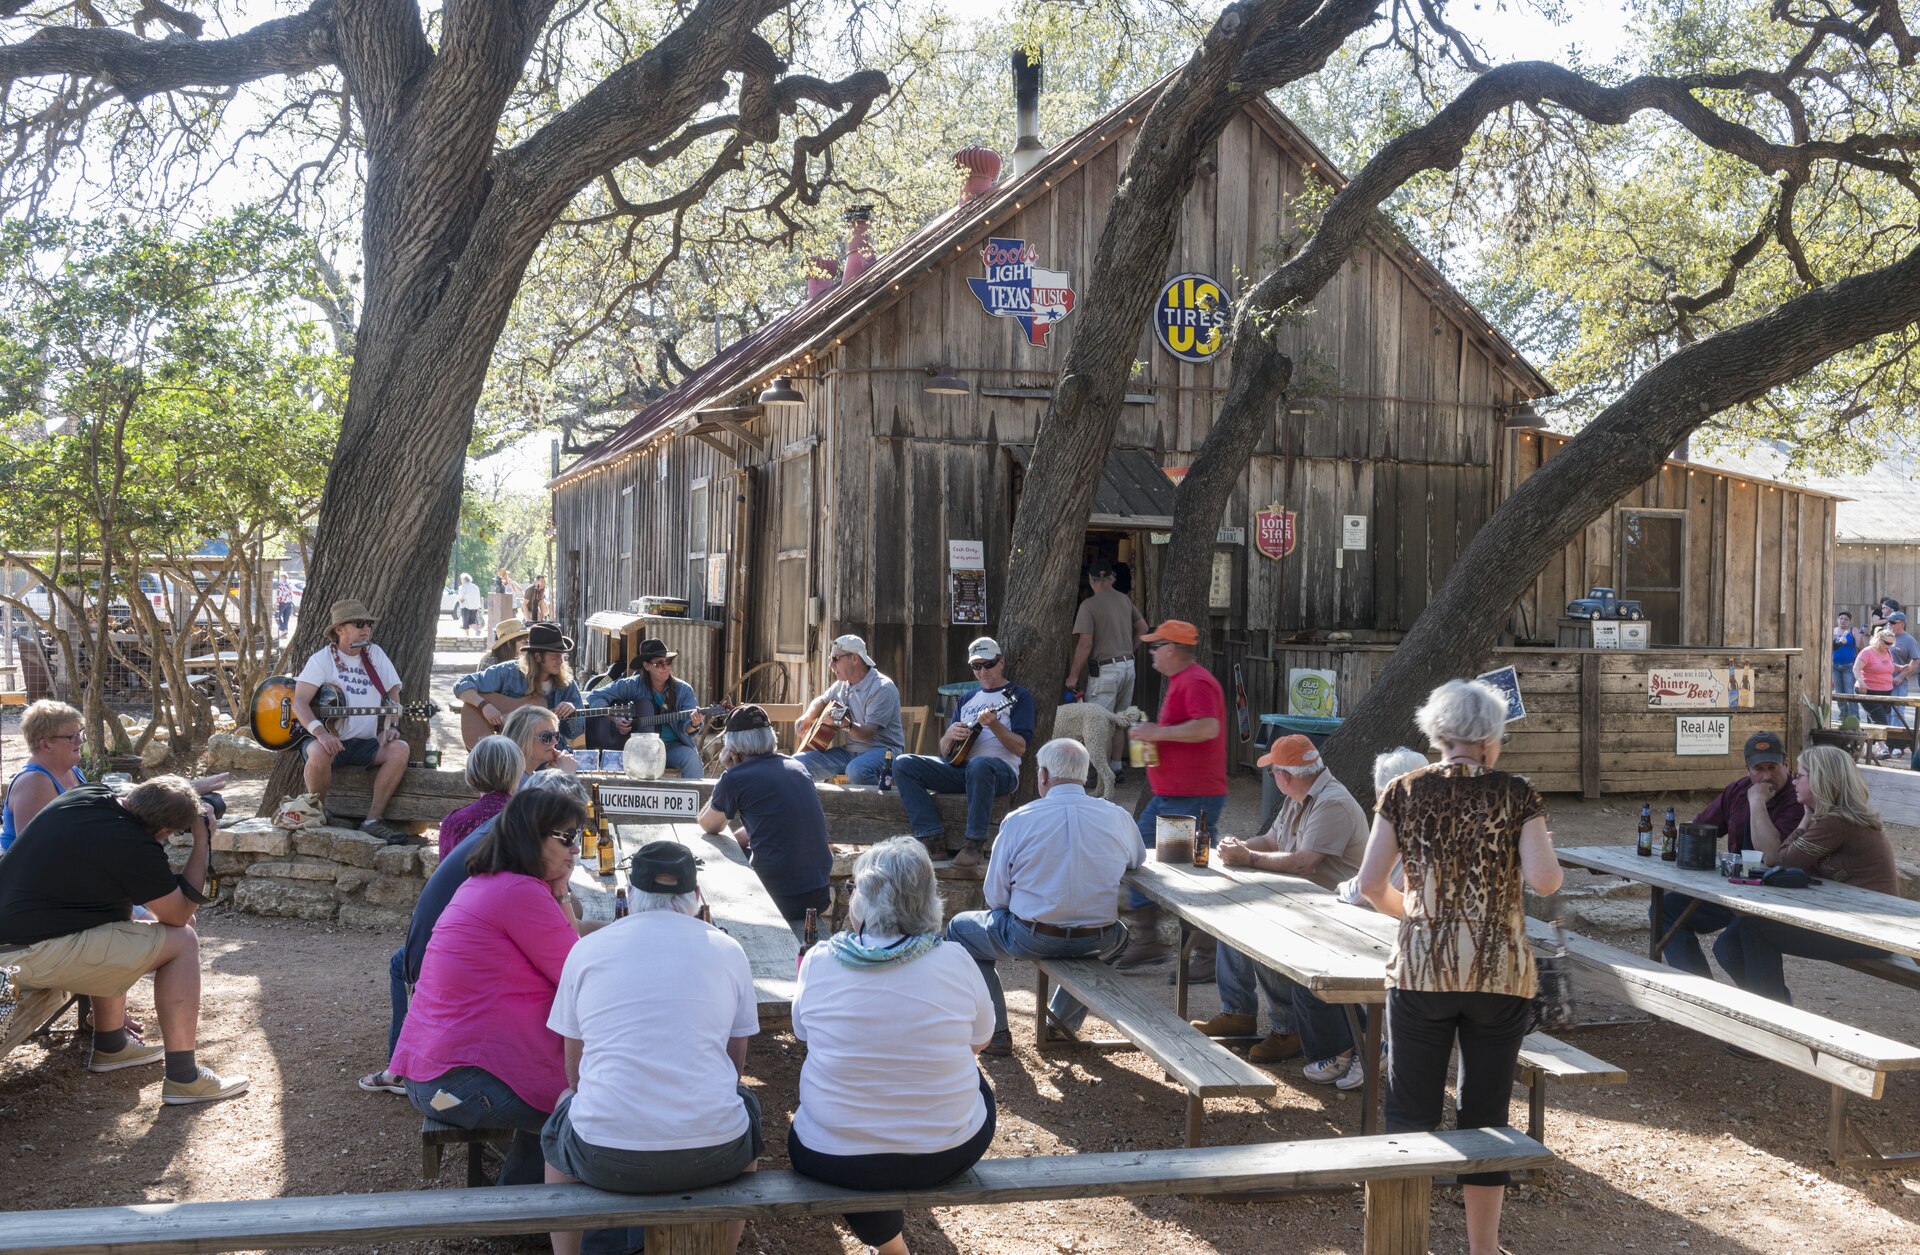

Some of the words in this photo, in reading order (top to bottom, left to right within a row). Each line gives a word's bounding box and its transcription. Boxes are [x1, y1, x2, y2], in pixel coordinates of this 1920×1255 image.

[983, 244, 1038, 266] Coors
[986, 263, 1034, 283] LIGHT
[989, 286, 1031, 309] TEXAS
[1033, 289, 1067, 306] MUSIC
[1164, 308, 1224, 327] TIRES
[1261, 518, 1291, 529] LONE
[1261, 529, 1292, 539] STAR
[1650, 674, 1689, 692] Shiner
[1687, 683, 1714, 699] Beer
[1681, 720, 1705, 733] Real
[1707, 719, 1725, 733] Ale
[601, 793, 659, 809] LUCKENBACH
[664, 796, 683, 810] POP.
[687, 797, 694, 811] 3
